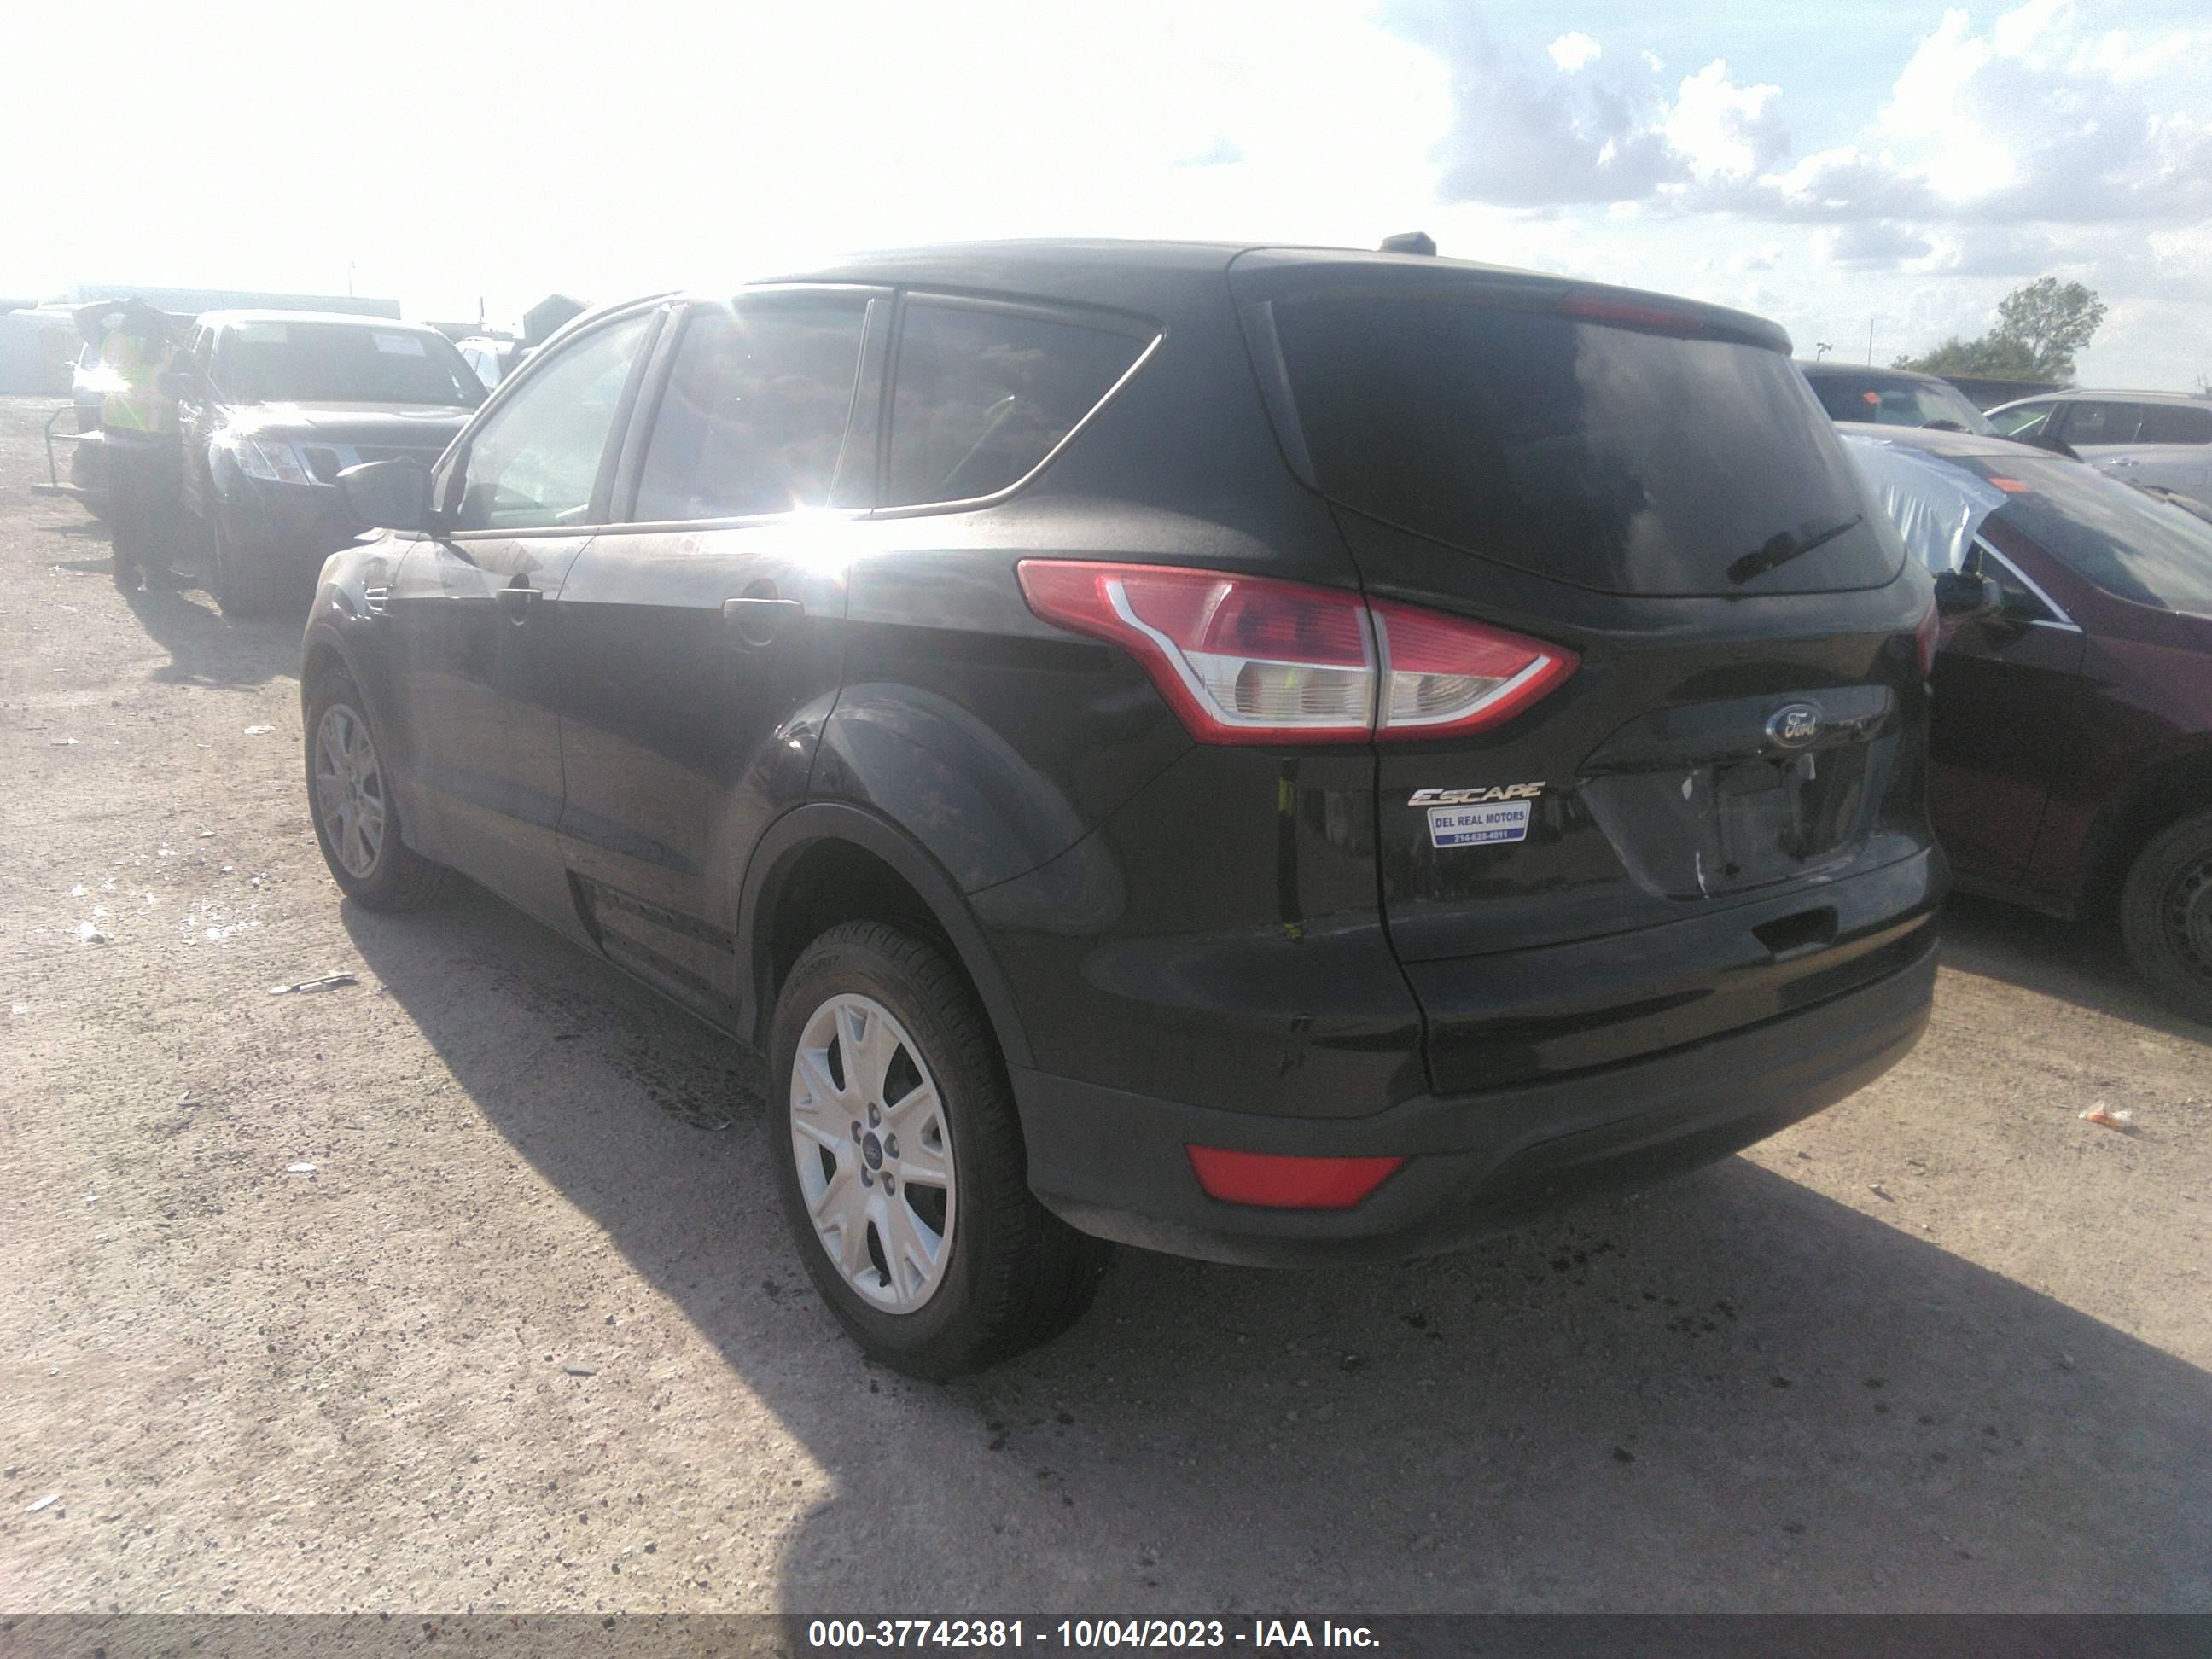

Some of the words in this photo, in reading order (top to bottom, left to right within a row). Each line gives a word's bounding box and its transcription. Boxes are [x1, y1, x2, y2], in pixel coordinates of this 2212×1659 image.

[1785, 712, 1816, 738] Ford
[1408, 781, 1546, 806] ESCAPE
[1435, 817, 1454, 828] DEL
[1458, 815, 1483, 826] REAL
[1487, 811, 1524, 824] MOTORS
